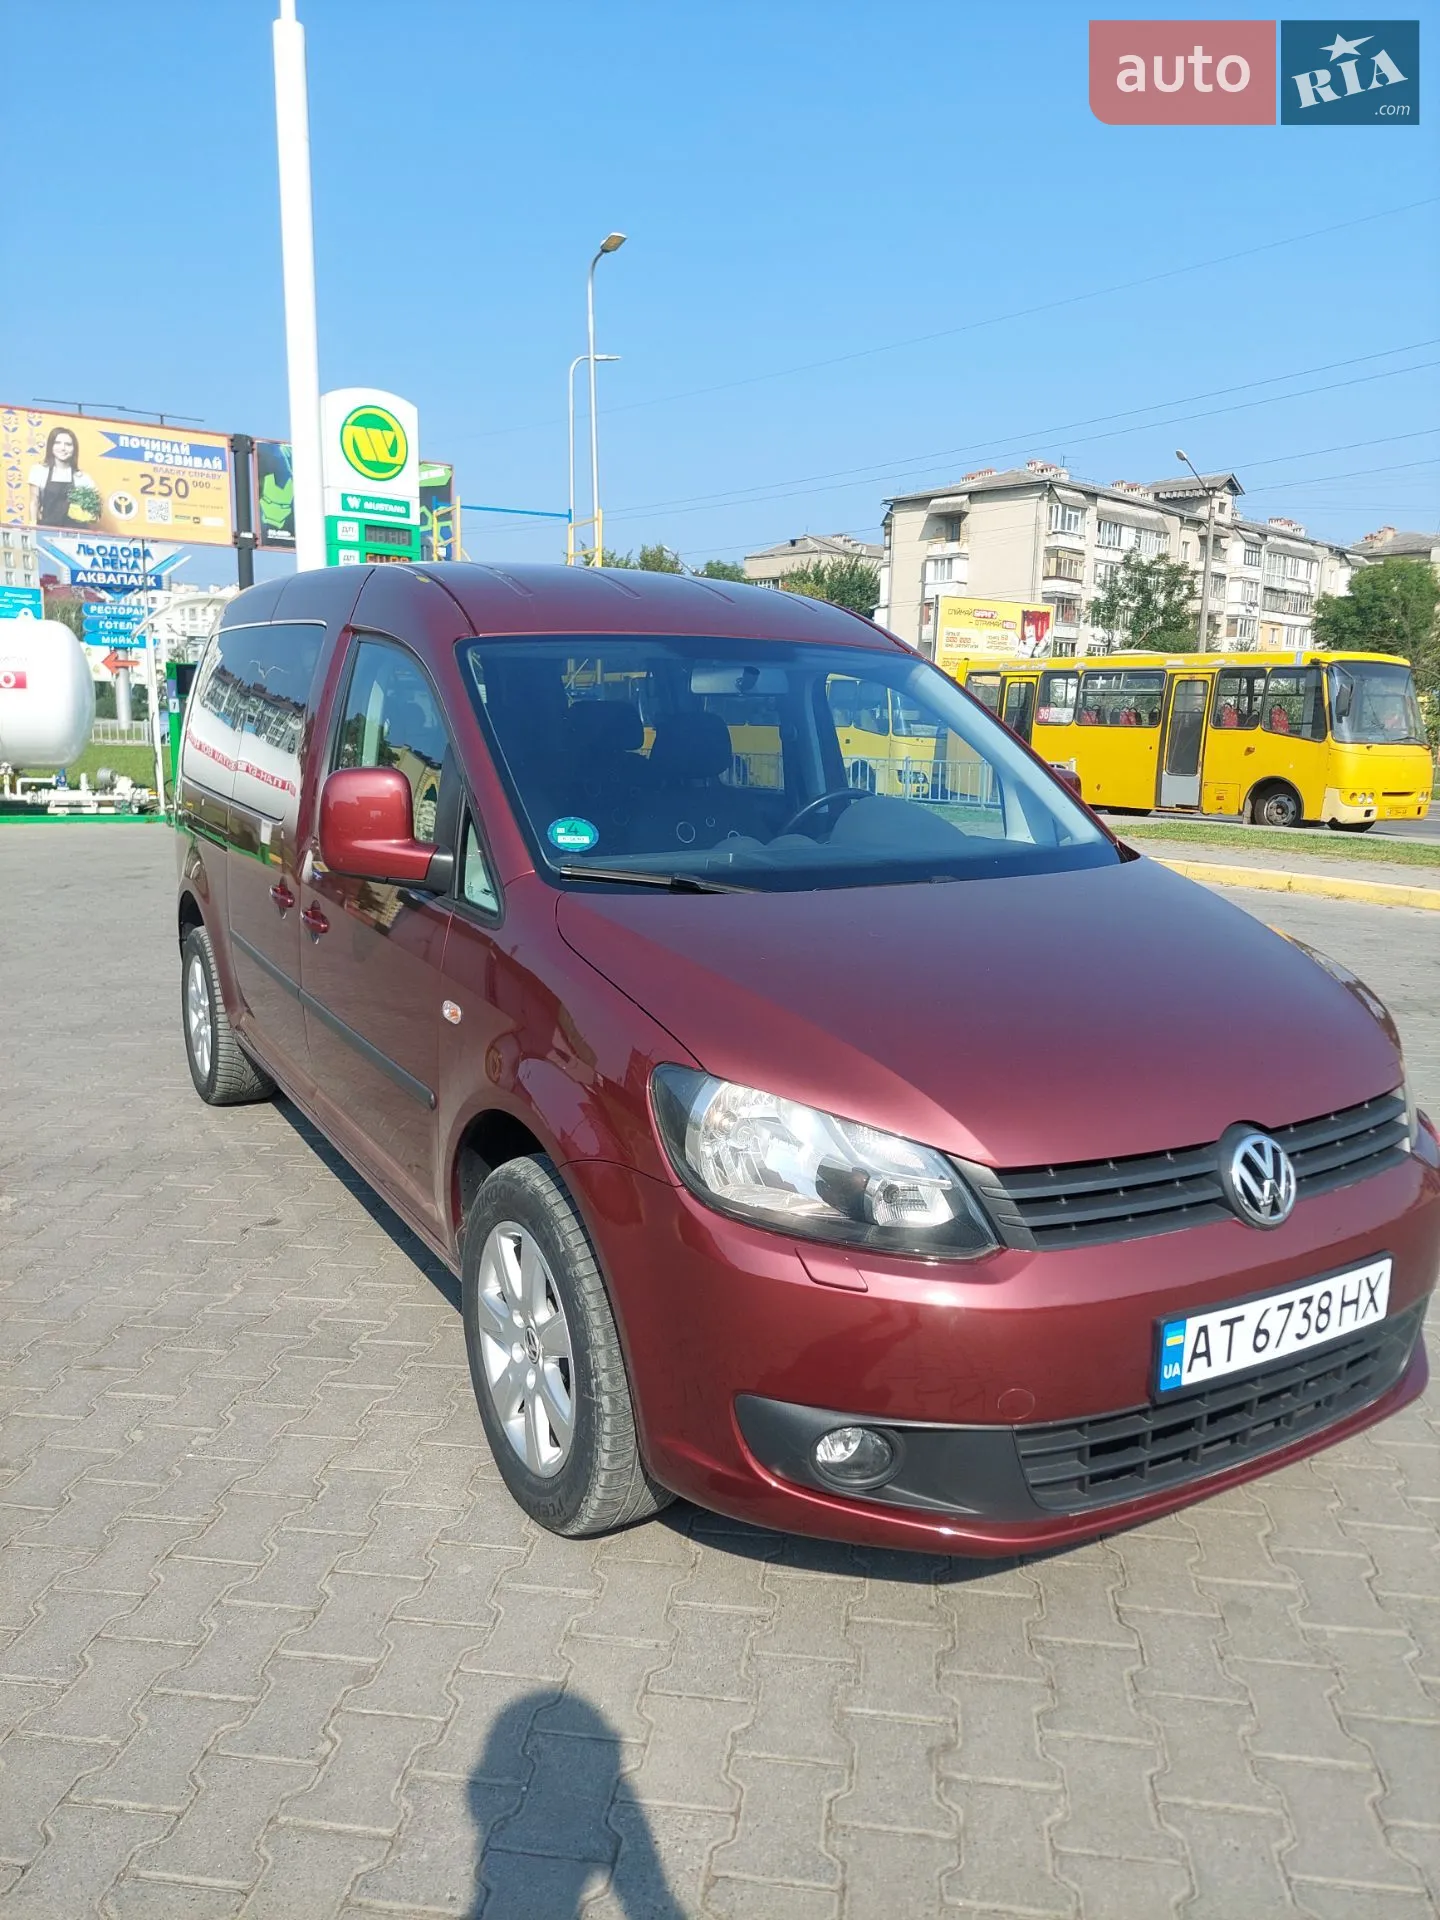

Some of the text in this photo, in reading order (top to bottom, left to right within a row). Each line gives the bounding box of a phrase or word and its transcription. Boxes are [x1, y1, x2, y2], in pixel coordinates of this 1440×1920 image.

[119, 435, 190, 456] ПОЧИНАЙ
[144, 452, 223, 471] РОЗВИВАЙ
[139, 474, 211, 499] 250 000
[76, 543, 154, 560] ЛЬОДОВА
[90, 555, 141, 570] АРЕНА
[76, 571, 157, 588] АКВАПАРК
[101, 633, 140, 645] МИЙКА
[1039, 708, 1049, 720] 36
[567, 822, 579, 835] 4
[1187, 1271, 1384, 1373] AT 6738 HX
[1164, 1364, 1181, 1379] UA
